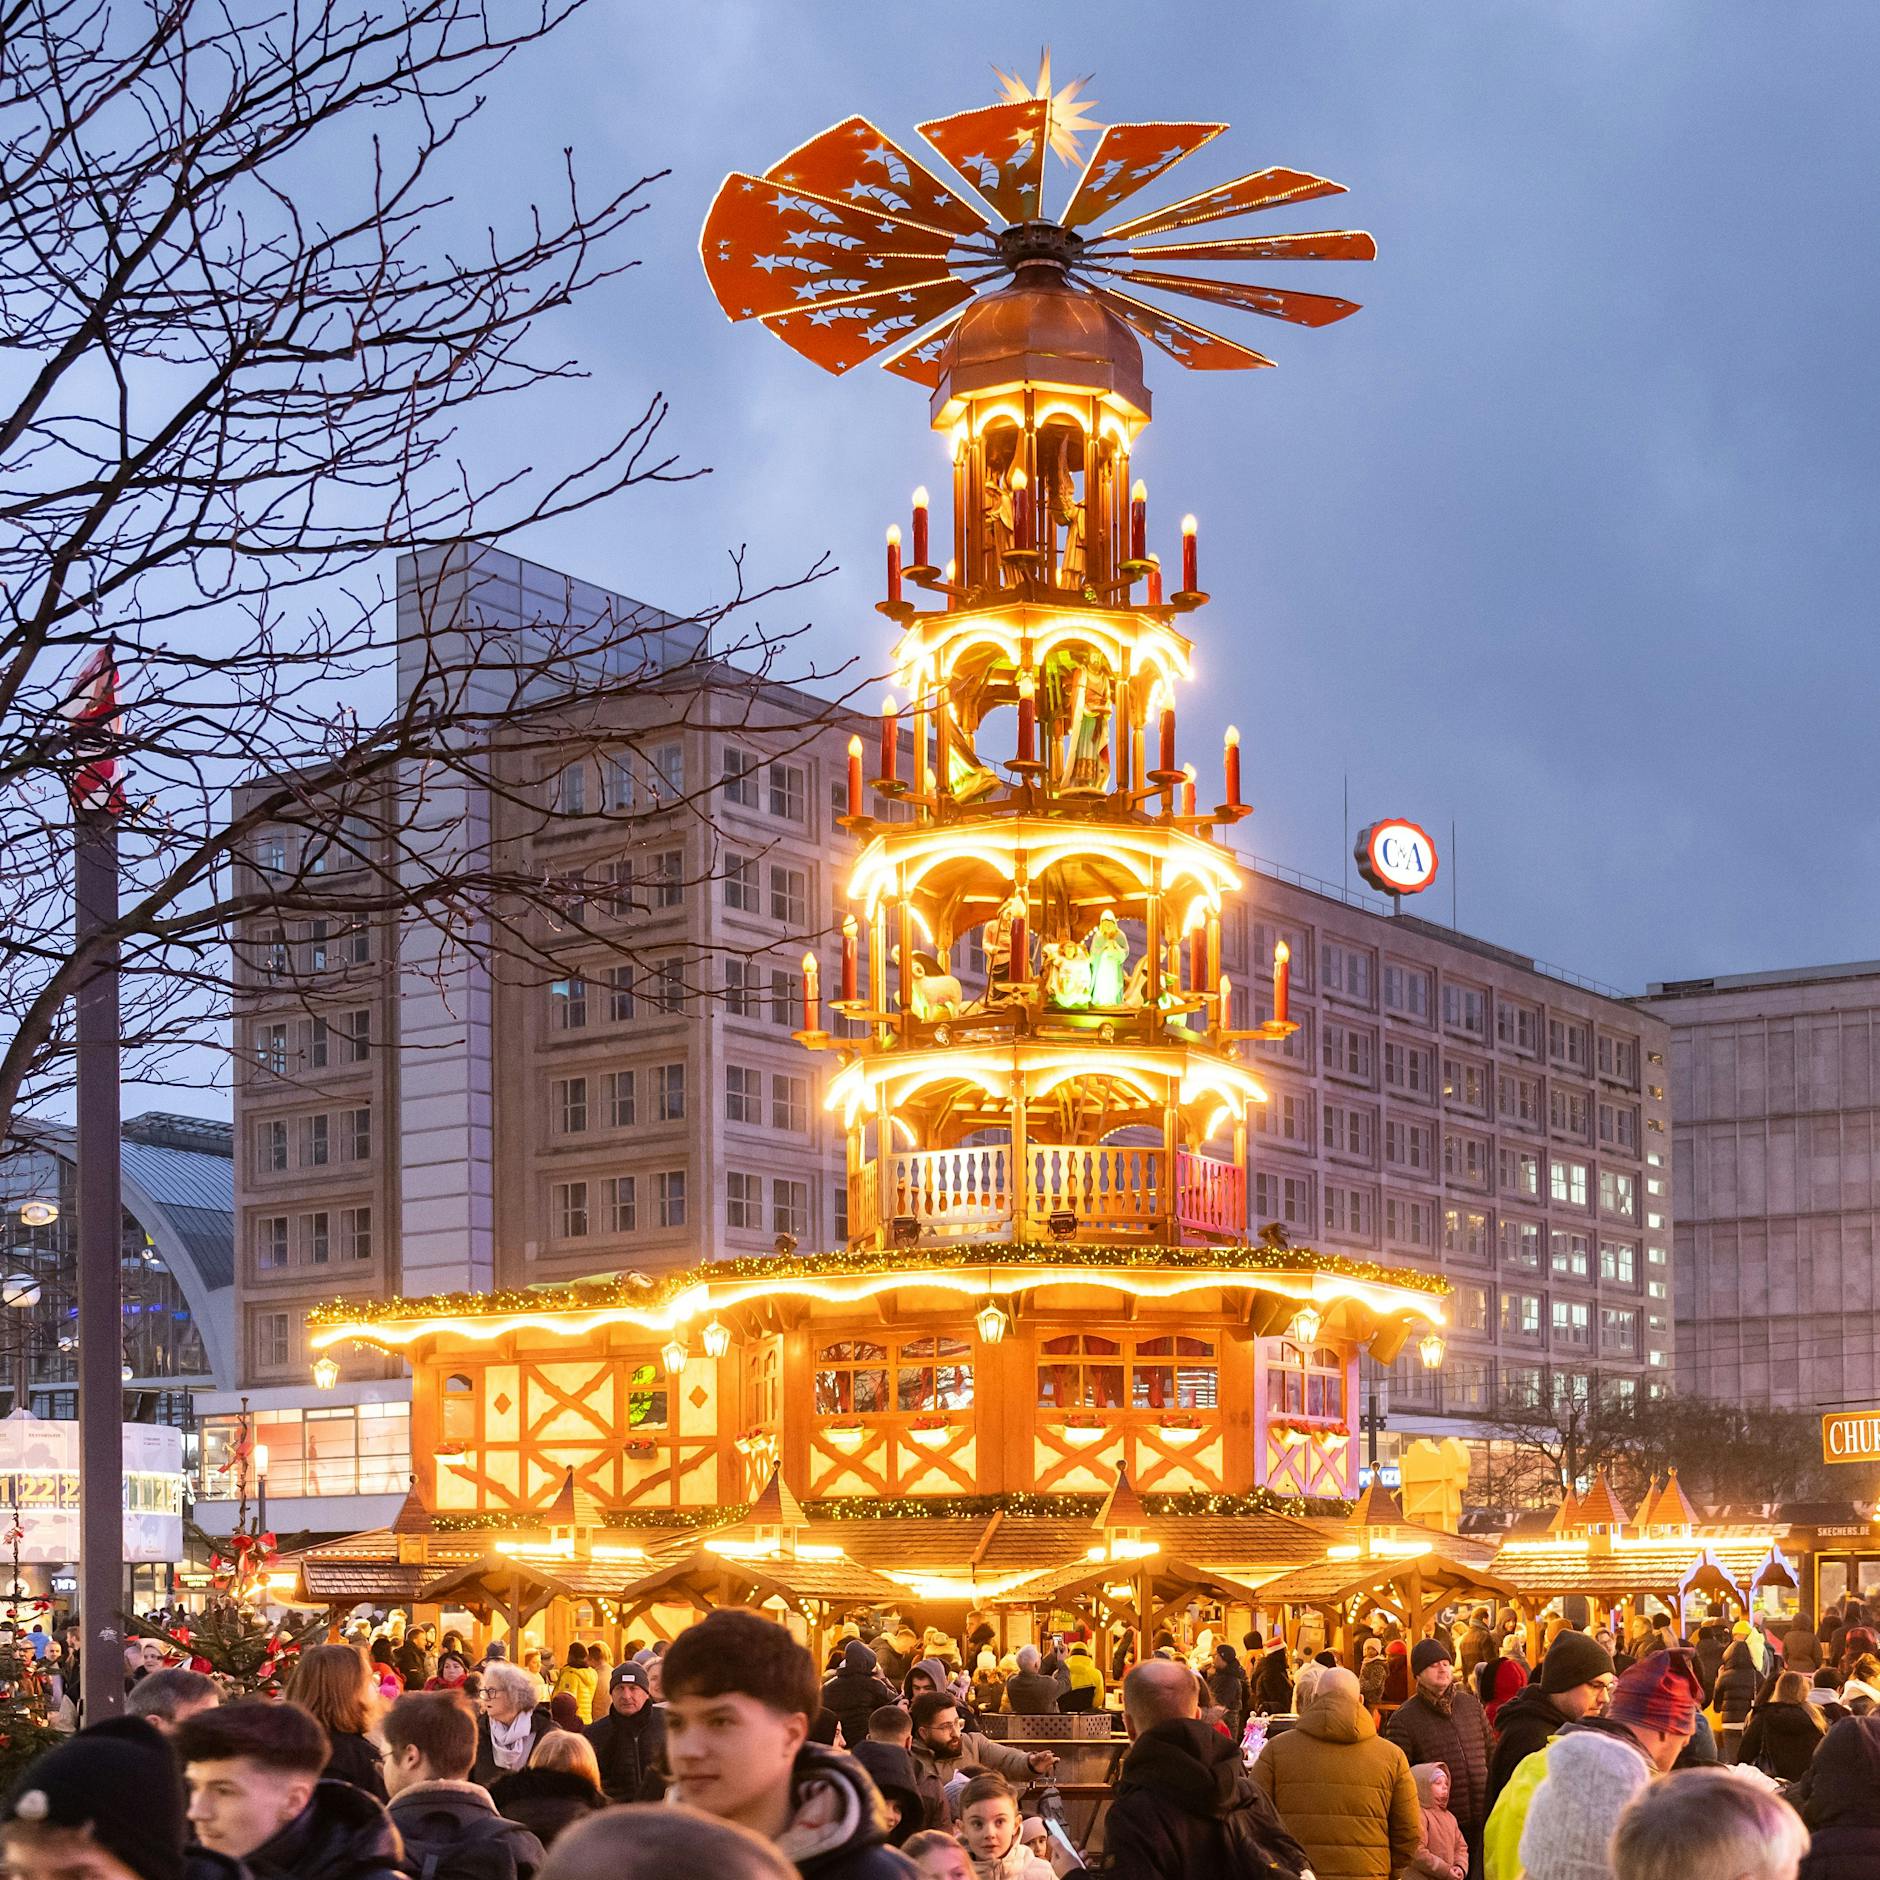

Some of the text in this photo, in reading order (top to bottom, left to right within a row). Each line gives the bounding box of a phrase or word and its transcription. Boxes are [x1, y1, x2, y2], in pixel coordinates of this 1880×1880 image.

[1382, 838, 1424, 873] C&A
[19, 1476, 55, 1502] 22
[1817, 1526, 1870, 1537] SKECHERS.DE
